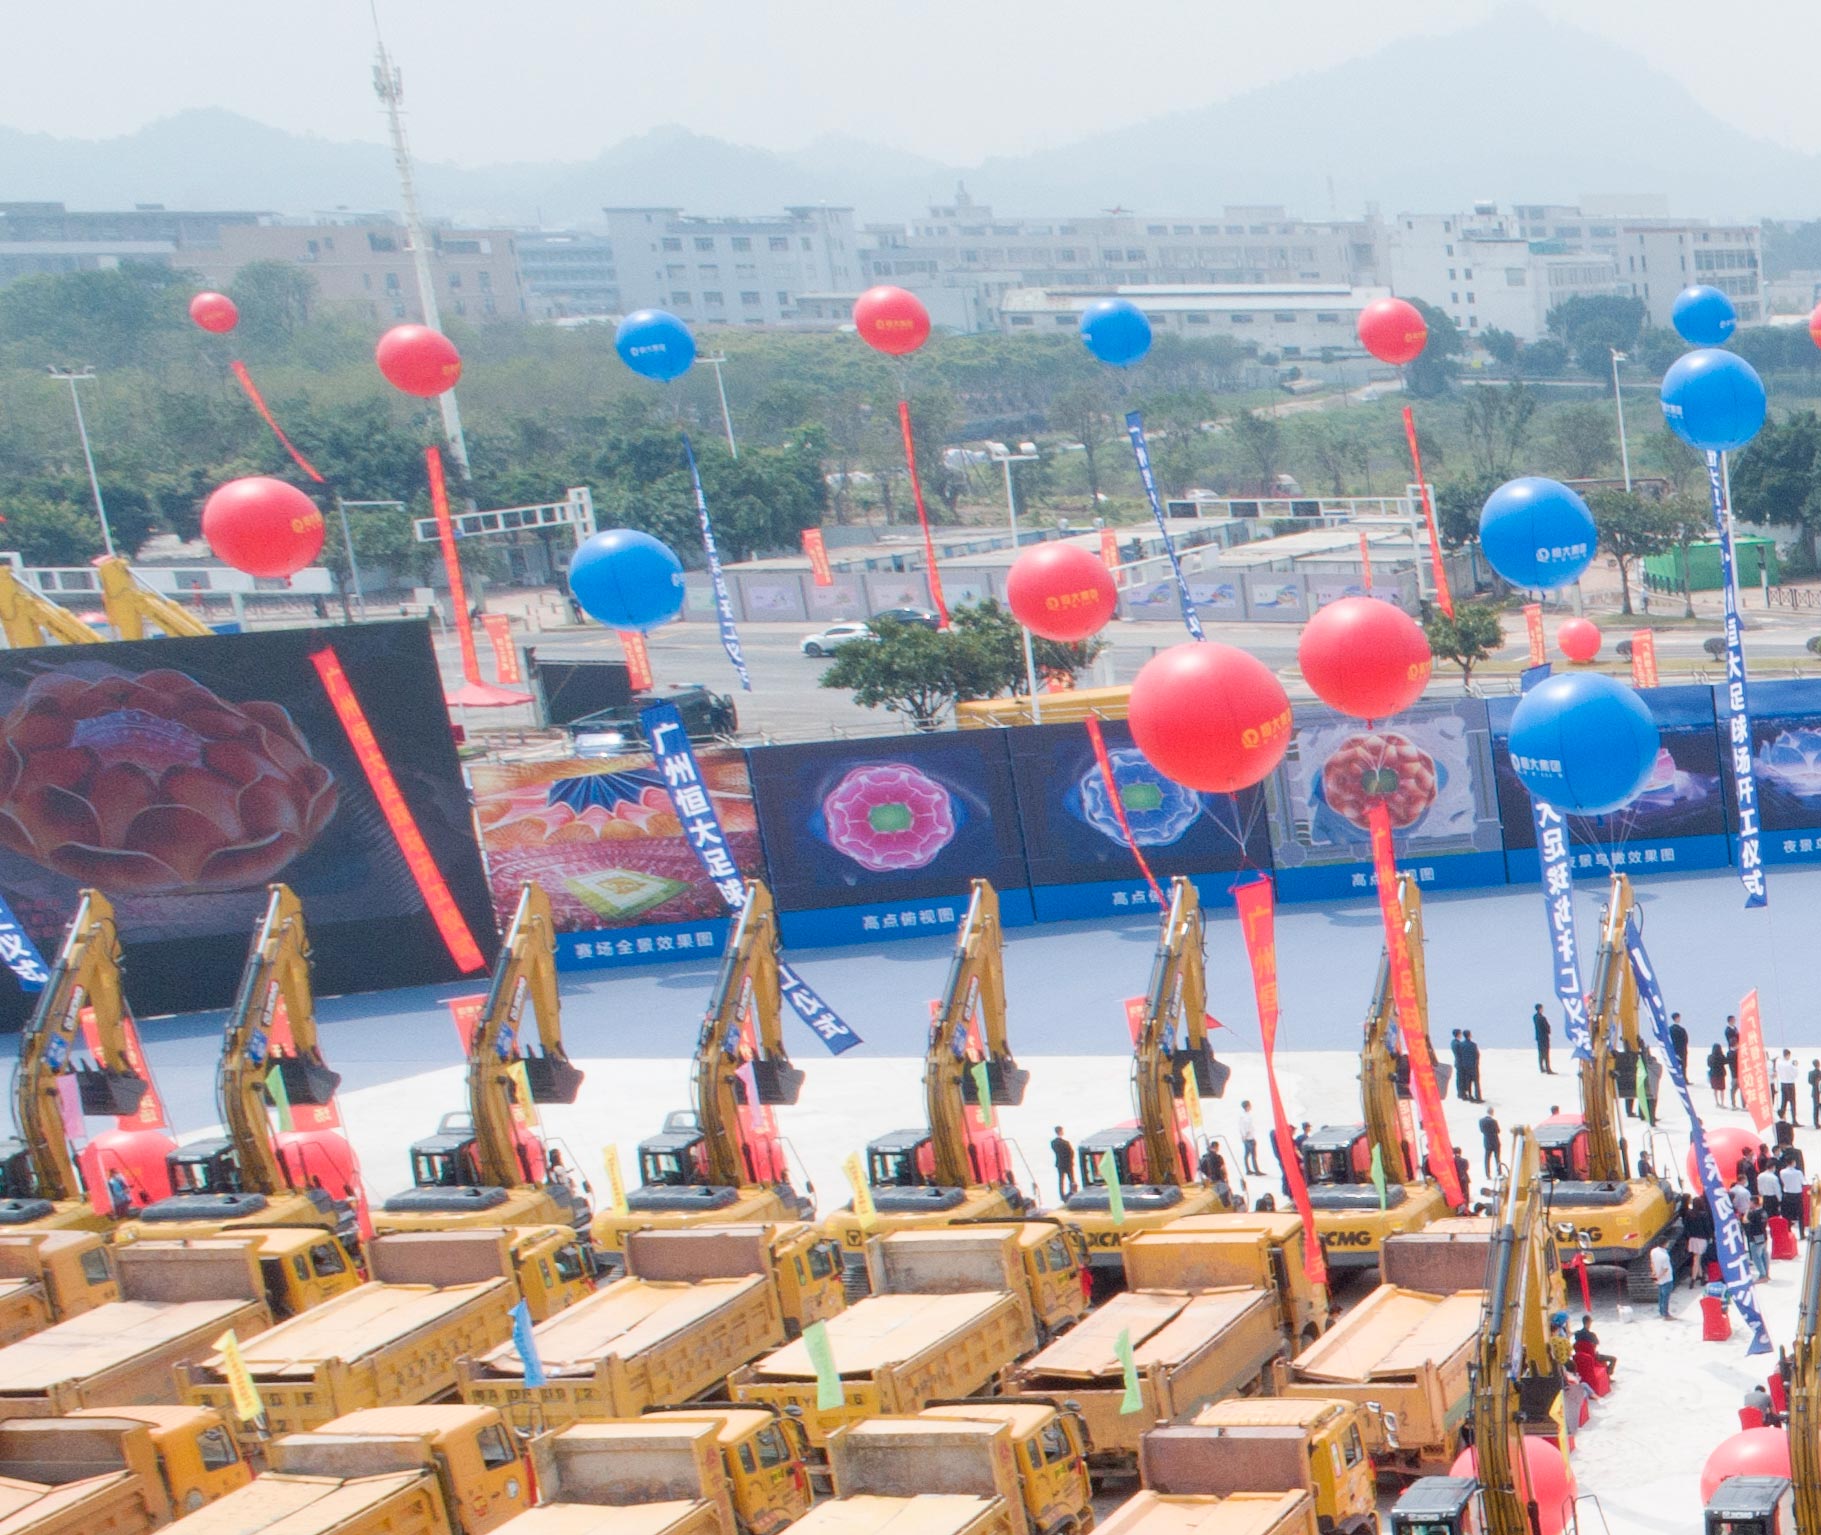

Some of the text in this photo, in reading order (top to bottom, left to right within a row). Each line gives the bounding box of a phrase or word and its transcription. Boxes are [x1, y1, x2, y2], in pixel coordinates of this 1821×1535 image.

[1552, 543, 1587, 556] 恒大集团
[1521, 757, 1561, 772] 恒大集团
[1351, 867, 1435, 887] 高点视图
[867, 906, 959, 931] 高点俯视图
[576, 931, 717, 960] 赛场全景效果图
[1321, 1231, 1371, 1246] CMG
